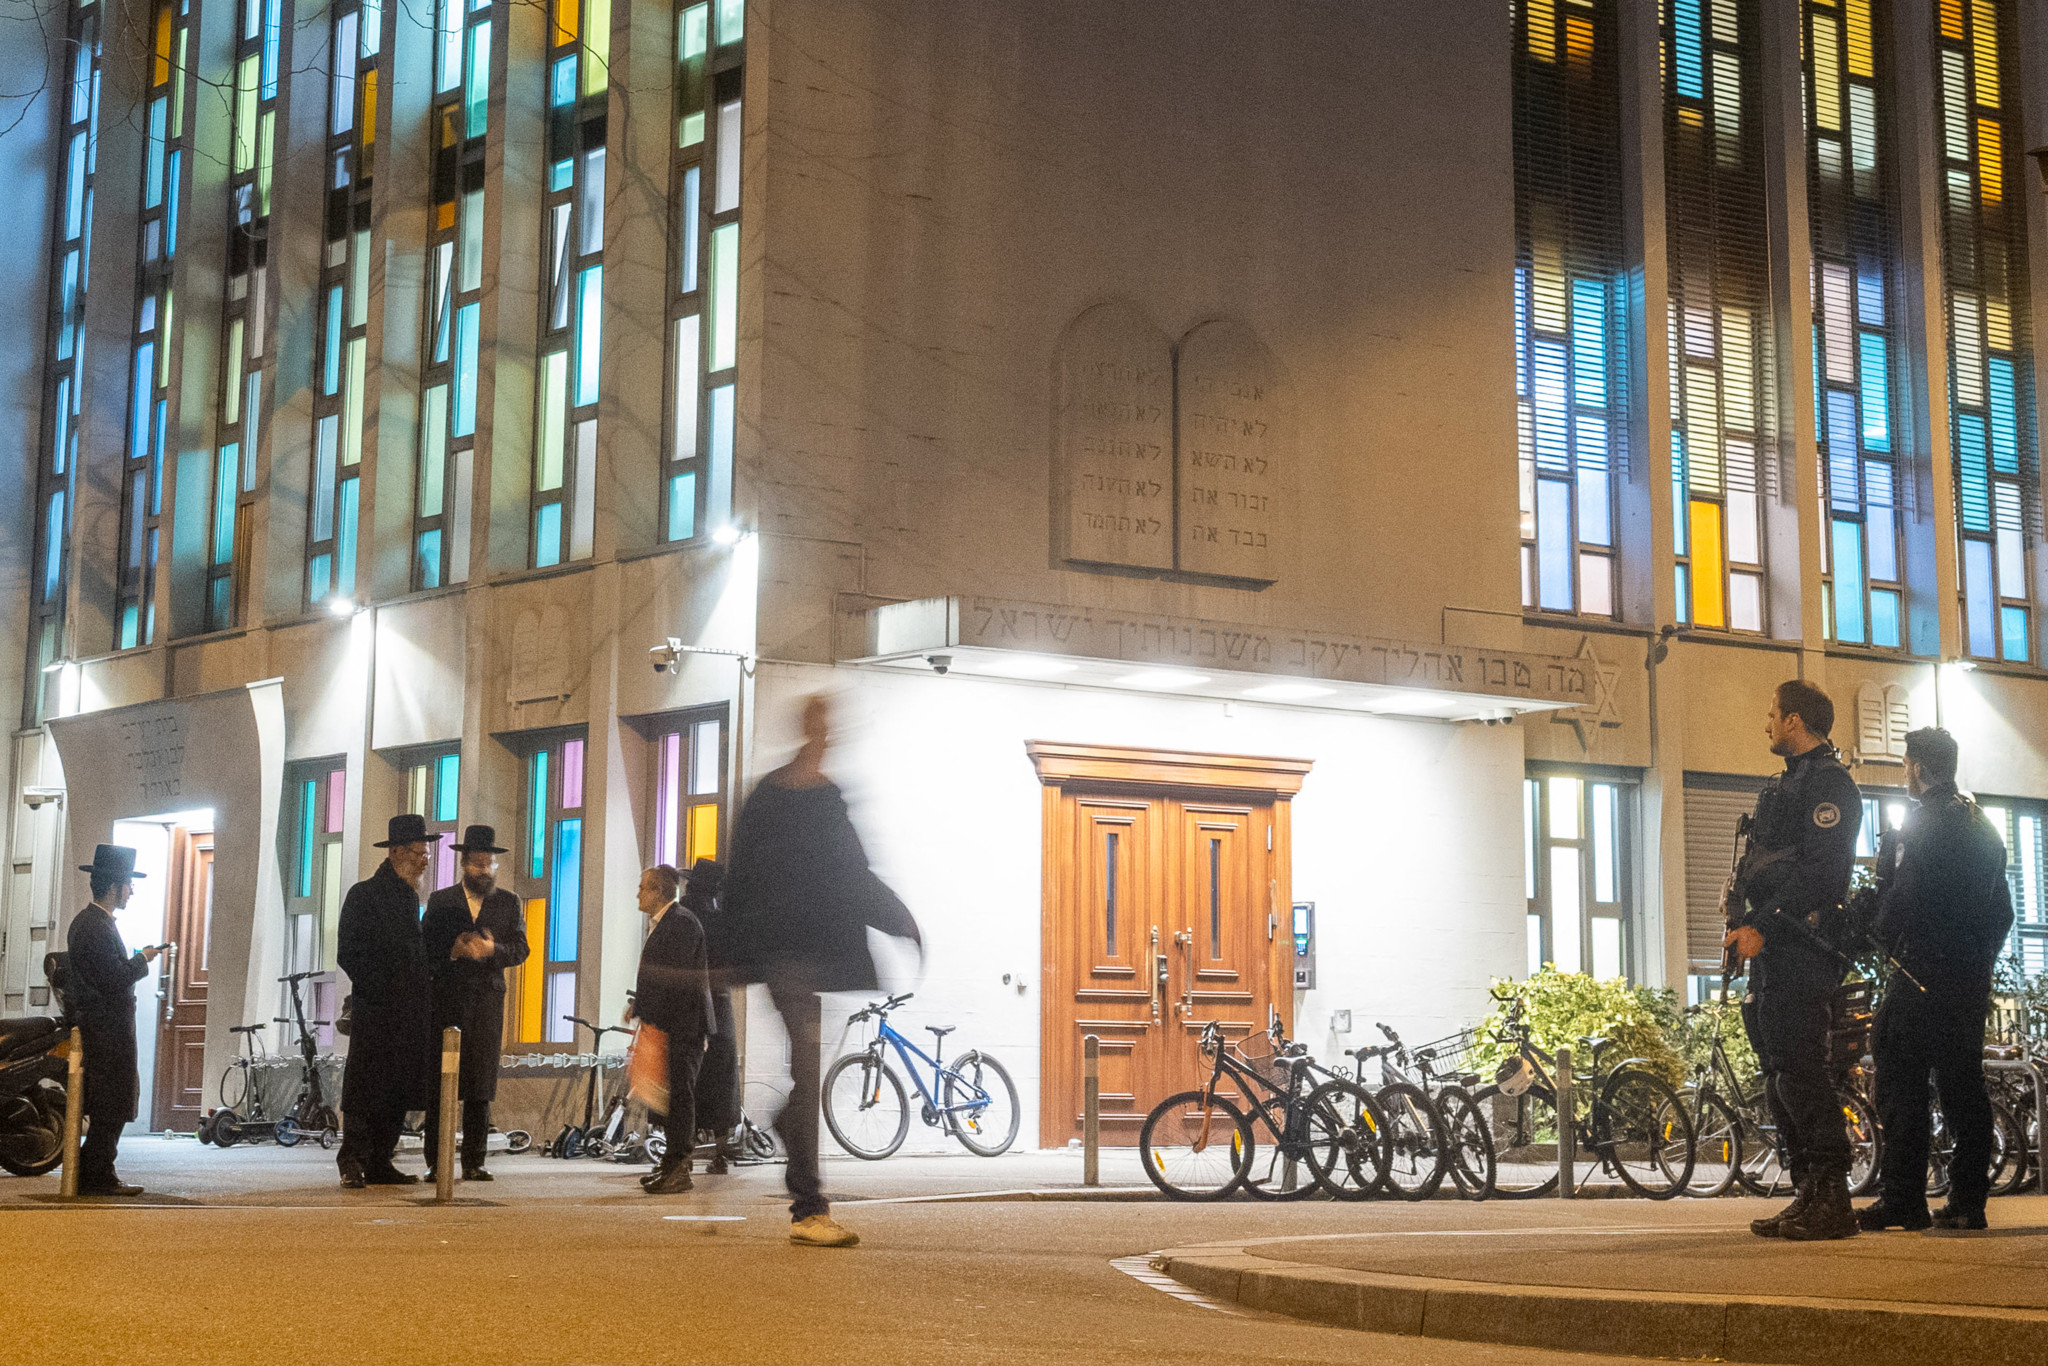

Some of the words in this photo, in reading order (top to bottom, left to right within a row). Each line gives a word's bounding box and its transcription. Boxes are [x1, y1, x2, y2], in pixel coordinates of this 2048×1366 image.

[1136, 405, 1161, 423] לא
[1243, 419, 1268, 438] לא
[1135, 443, 1161, 460] לא
[1192, 451, 1236, 470] תשא
[1243, 457, 1268, 476] לא
[1135, 479, 1161, 497] לא
[1192, 487, 1218, 506] את
[1227, 492, 1269, 512] זכור
[1082, 512, 1130, 532] תחמד
[1135, 517, 1161, 535] לא
[1192, 525, 1218, 543] את
[1227, 529, 1268, 549] כבד
[973, 598, 1094, 645] ישראל
[1288, 637, 1361, 678] יעקב
[1371, 643, 1465, 685] אהליך
[1547, 663, 1586, 694] מה
